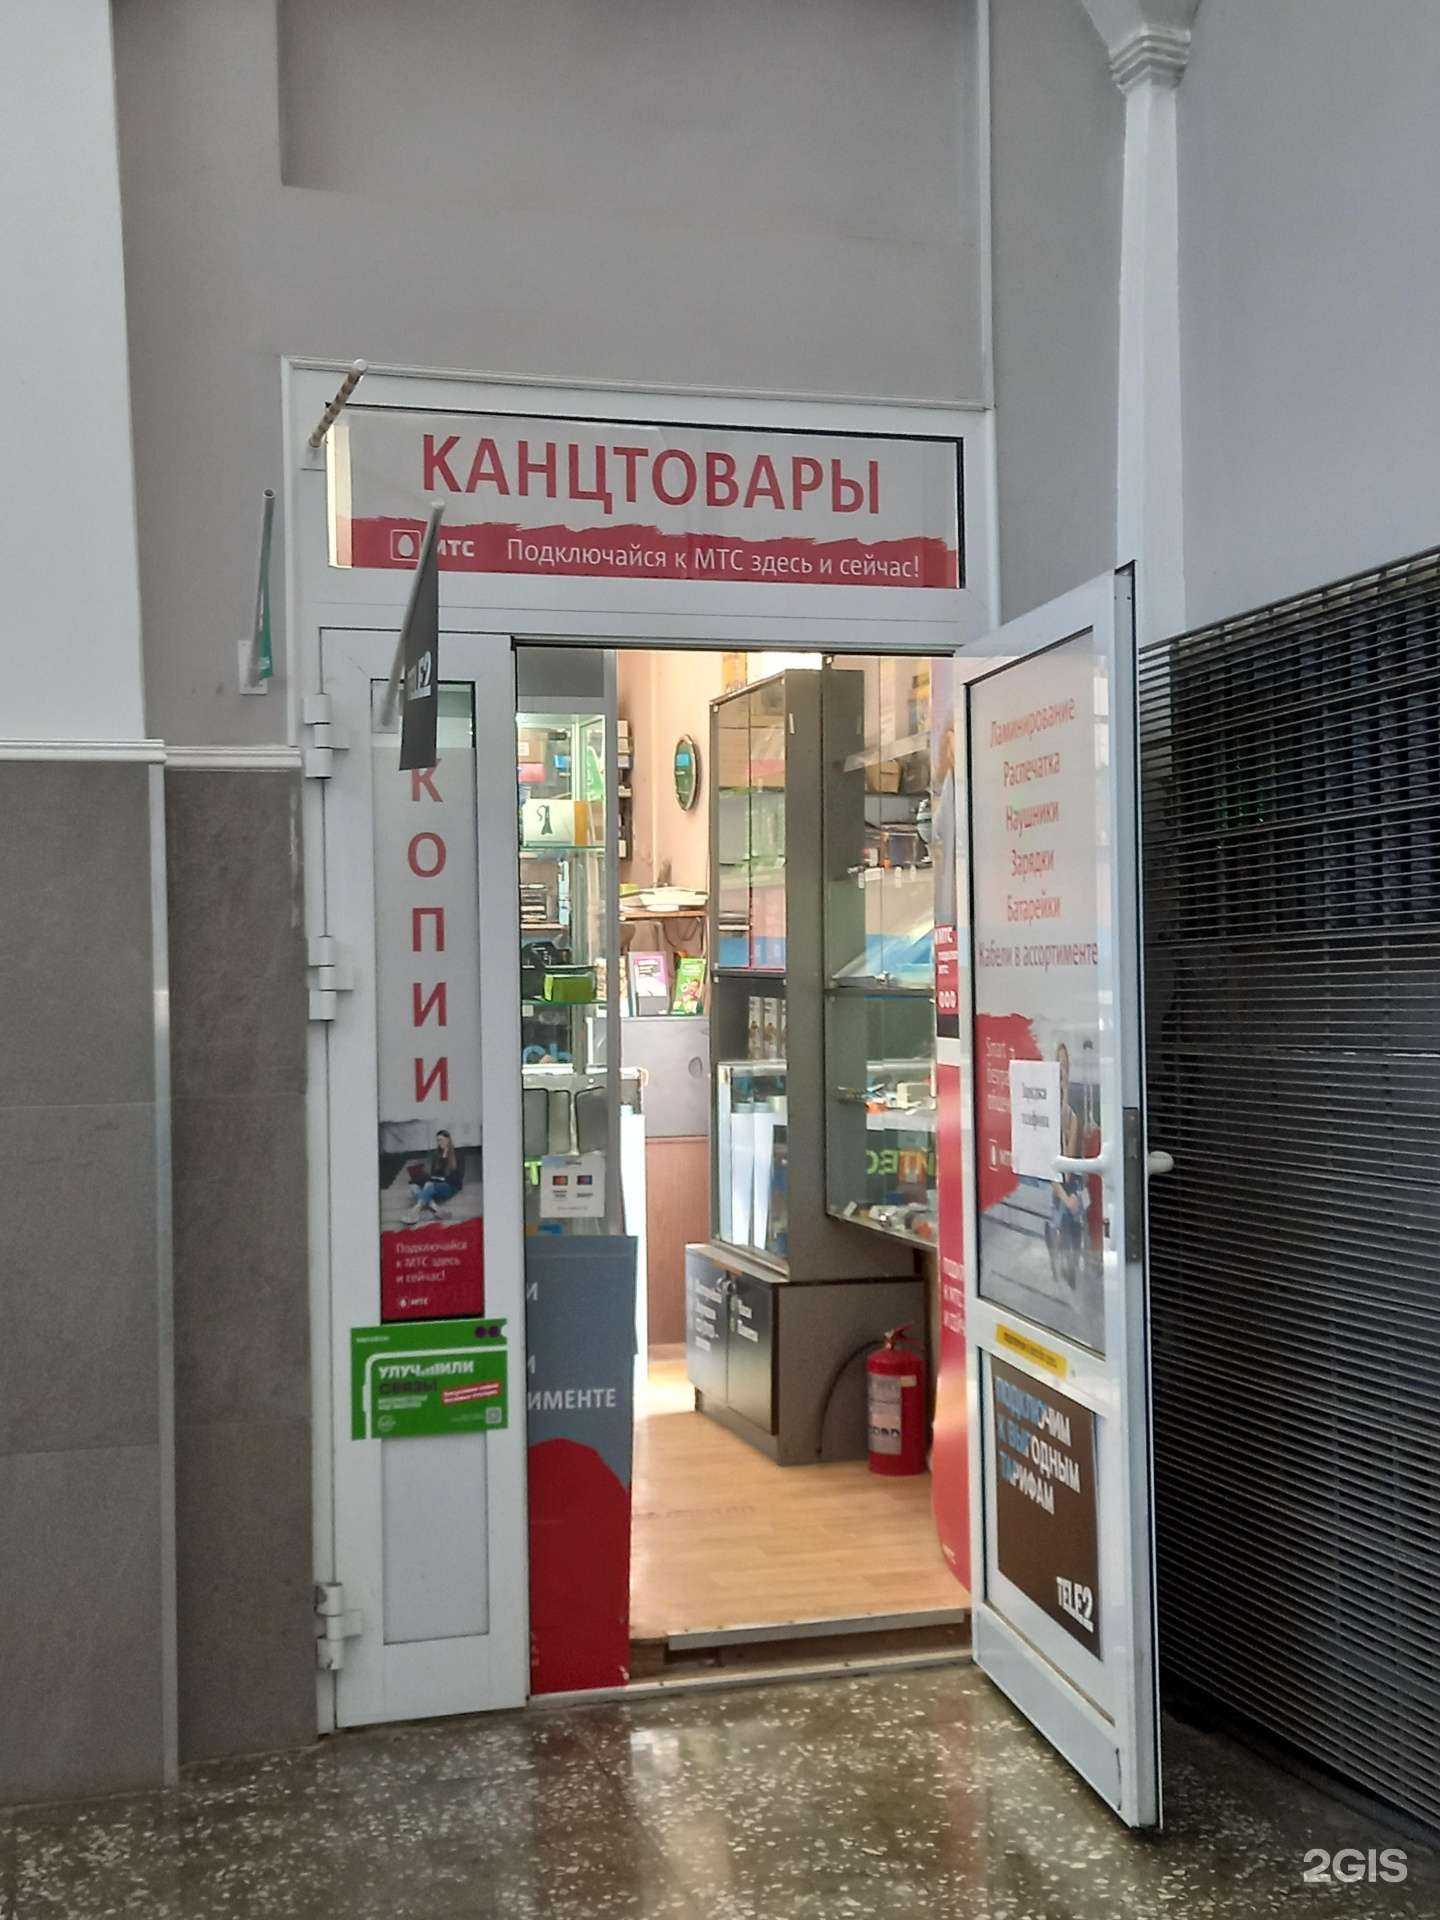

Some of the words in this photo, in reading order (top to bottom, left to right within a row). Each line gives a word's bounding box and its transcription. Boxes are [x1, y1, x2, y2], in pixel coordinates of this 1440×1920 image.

[422, 433, 880, 515] КАНЦТОВАРЫ
[507, 538, 667, 569] Подключайся
[675, 552, 688, 569] к
[695, 548, 744, 571] МТС
[752, 555, 812, 574] здесь
[820, 557, 832, 574] и
[840, 554, 920, 578] сейчас!
[990, 697, 1076, 748] Ламинирование
[1003, 752, 1061, 787] Распечатка
[1006, 801, 1060, 838] Наушники
[1011, 849, 1055, 881] Зарядки
[1007, 888, 1061, 927] Батарейки
[407, 757, 449, 1103] КОПИИ
